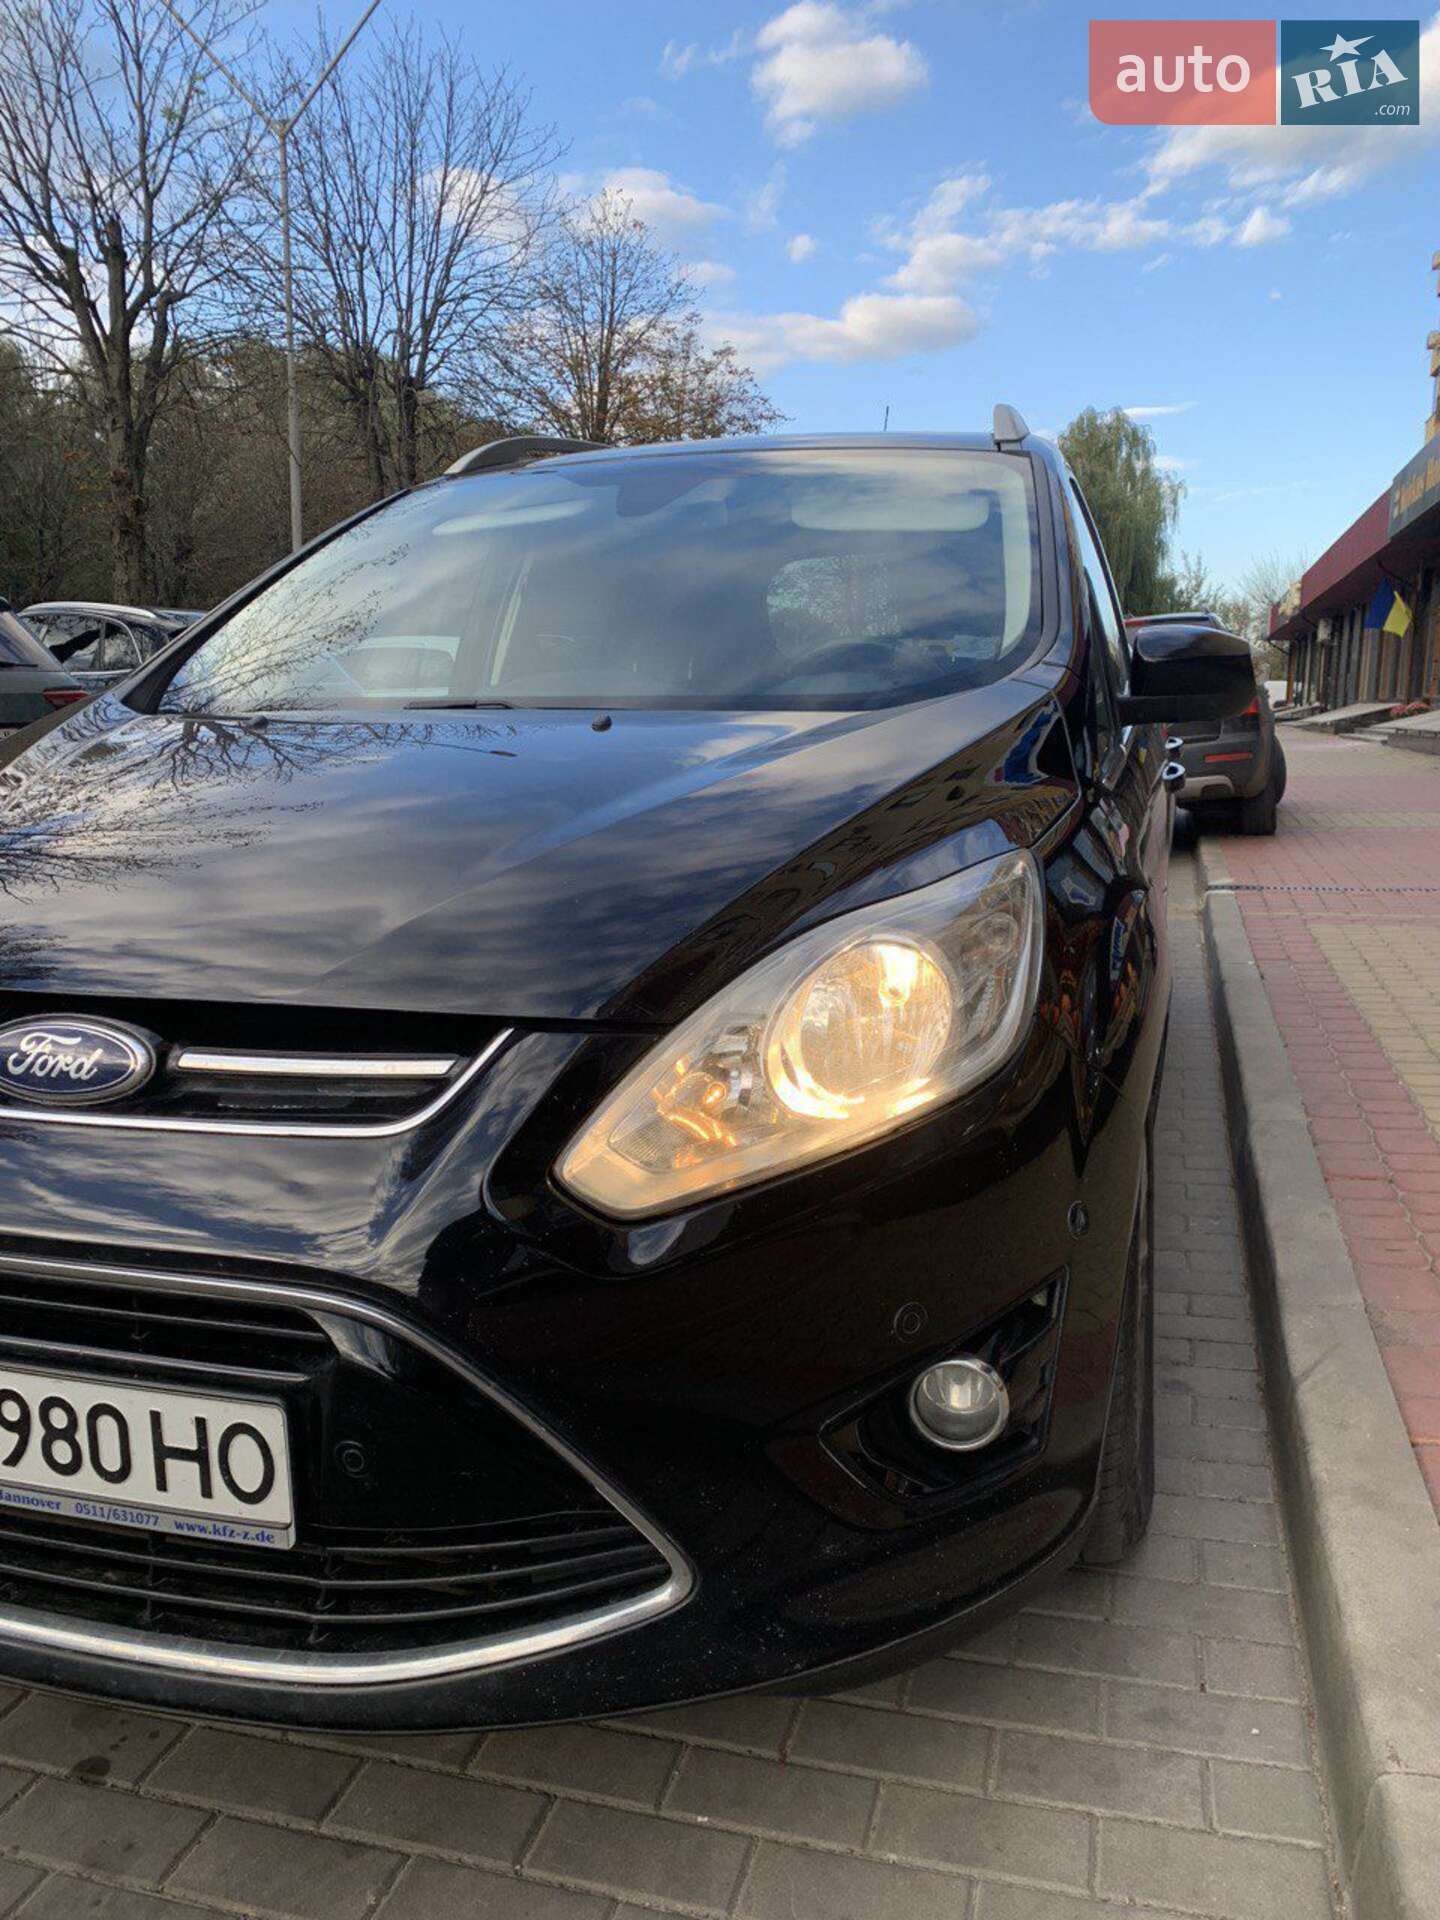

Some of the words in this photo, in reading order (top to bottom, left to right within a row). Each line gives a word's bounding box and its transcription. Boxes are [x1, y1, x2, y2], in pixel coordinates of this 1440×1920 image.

[7, 1031, 104, 1081] Ford
[0, 1388, 132, 1484] 980
[149, 1410, 275, 1505] HO
[75, 1502, 160, 1527] 0511/631077
[174, 1520, 275, 1543] www.kfz-z.de
